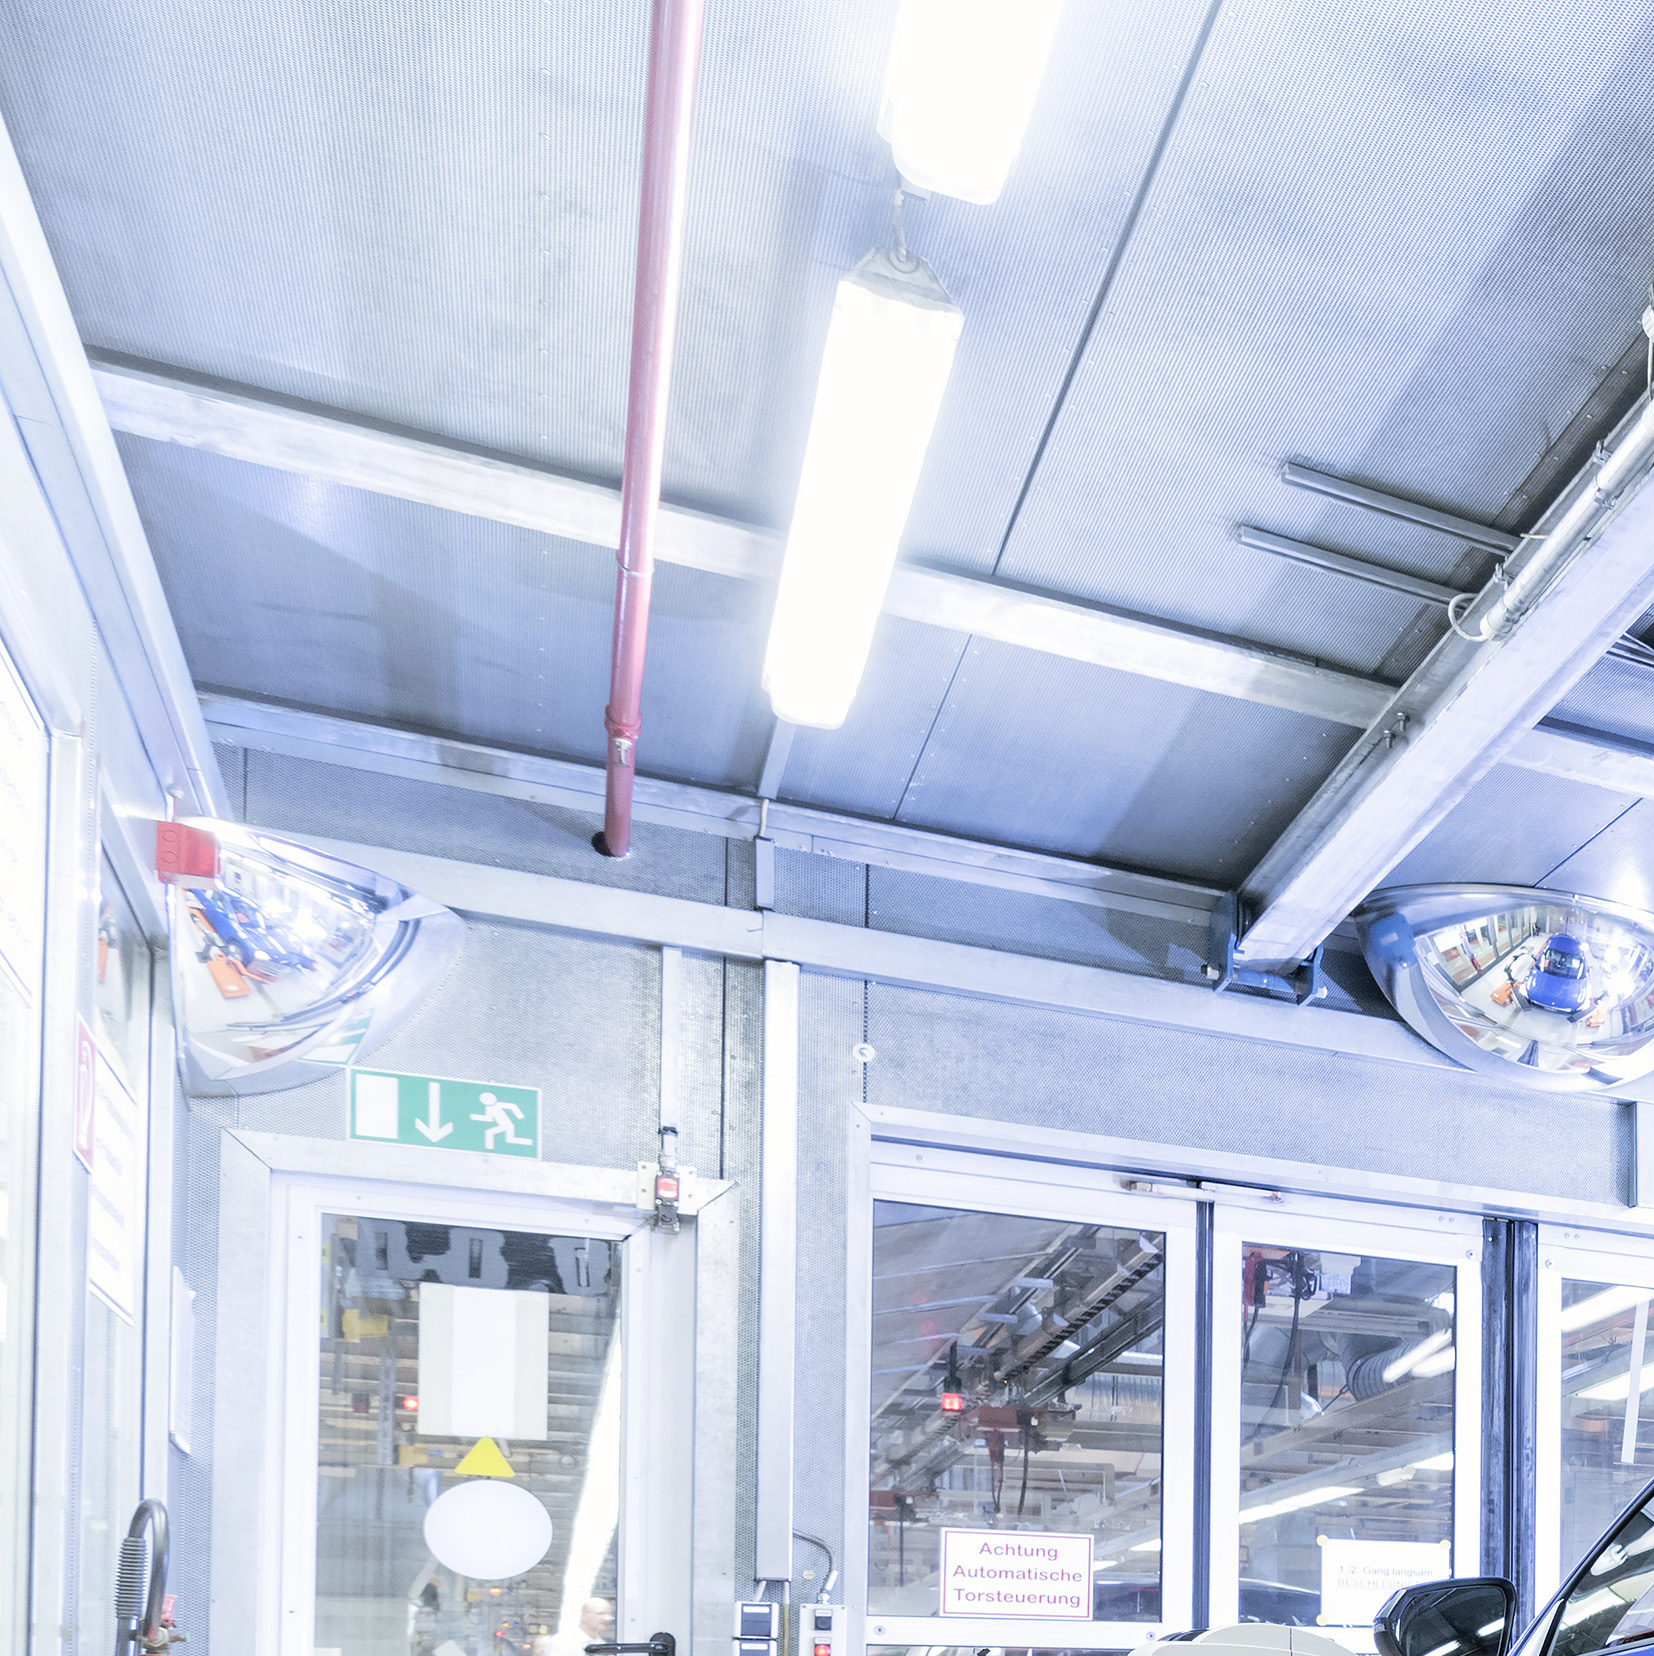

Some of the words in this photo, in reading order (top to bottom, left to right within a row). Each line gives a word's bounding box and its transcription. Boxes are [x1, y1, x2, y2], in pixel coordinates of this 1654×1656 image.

[979, 1542, 1058, 1561] Achtung
[952, 1564, 1083, 1582] Automatische
[1363, 1566, 1389, 1576] Gang
[1392, 1567, 1432, 1577] langsam
[953, 1587, 1081, 1609] Torsteuerung
